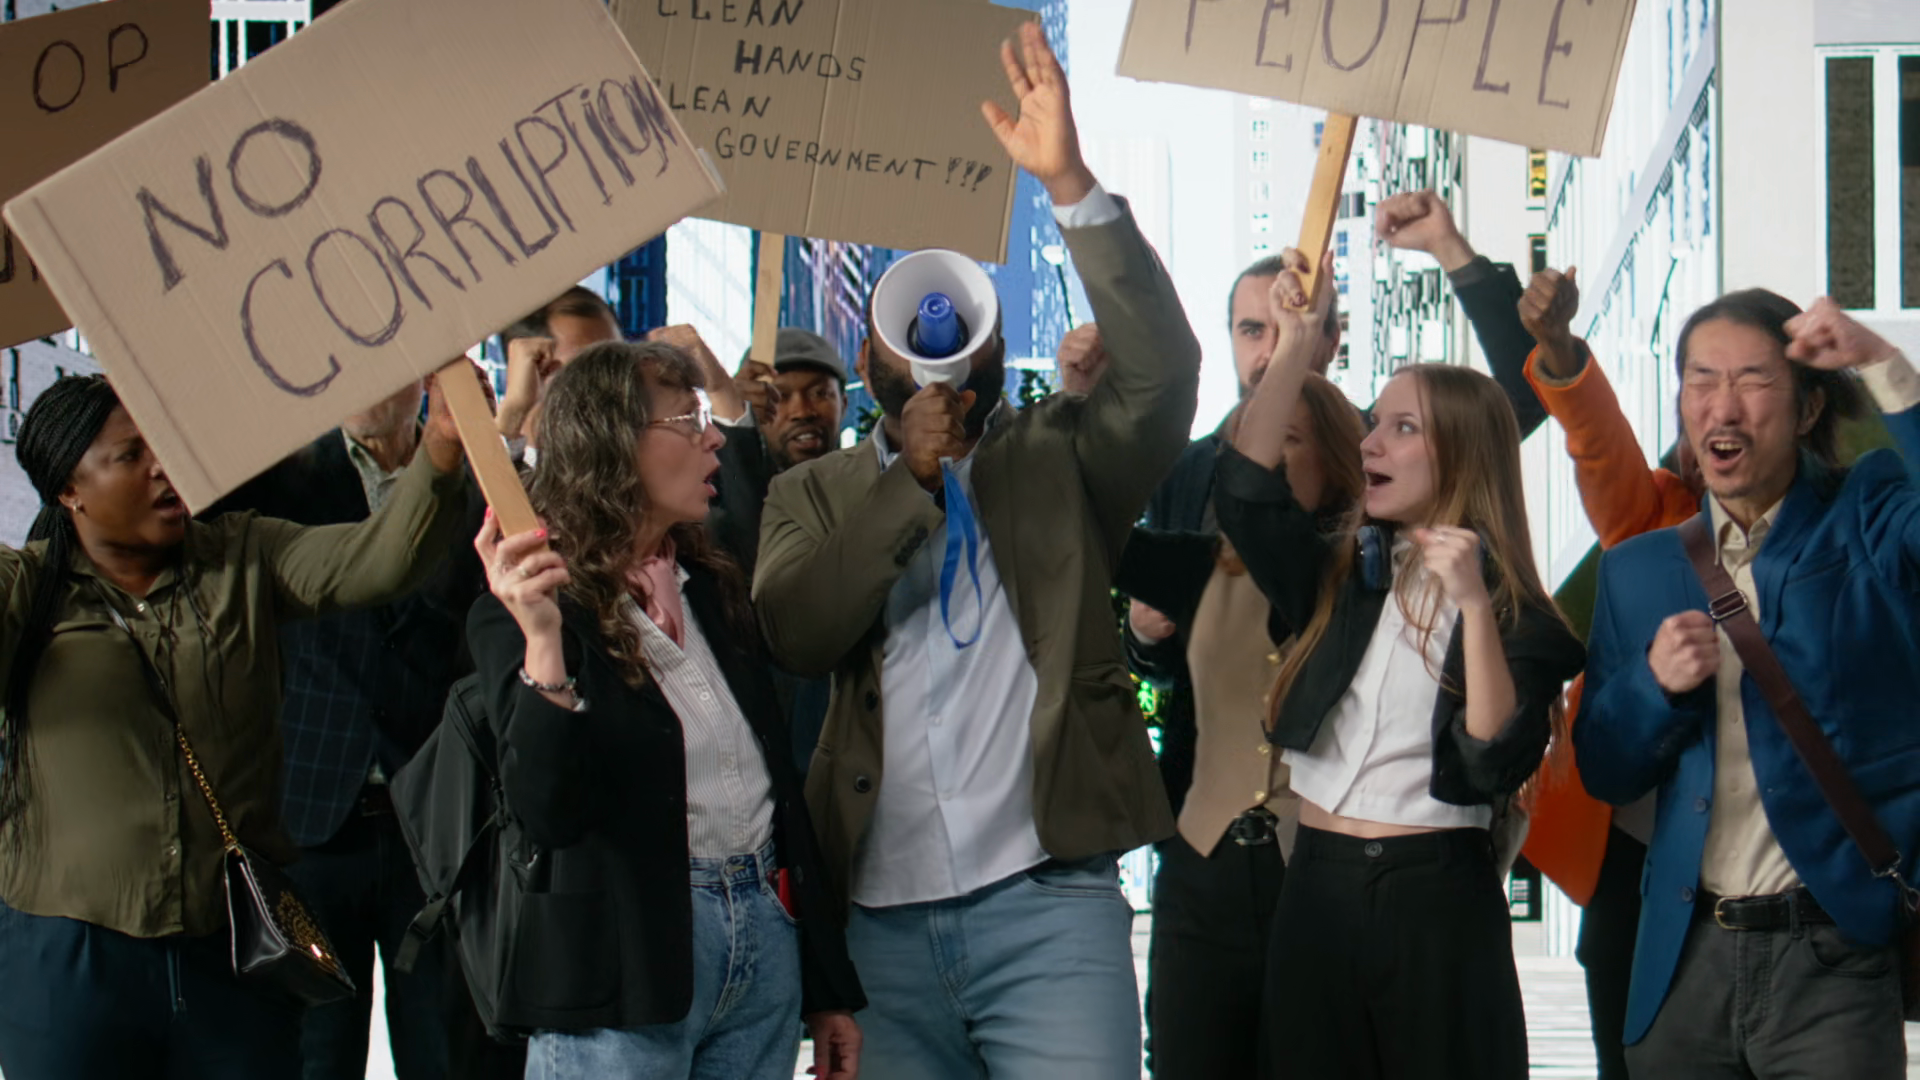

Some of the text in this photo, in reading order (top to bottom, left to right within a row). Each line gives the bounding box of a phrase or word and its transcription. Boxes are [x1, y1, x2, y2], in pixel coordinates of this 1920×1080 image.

[734, 39, 866, 82] HANDS
[655, 78, 771, 118] LEAN
[136, 118, 322, 295] NO
